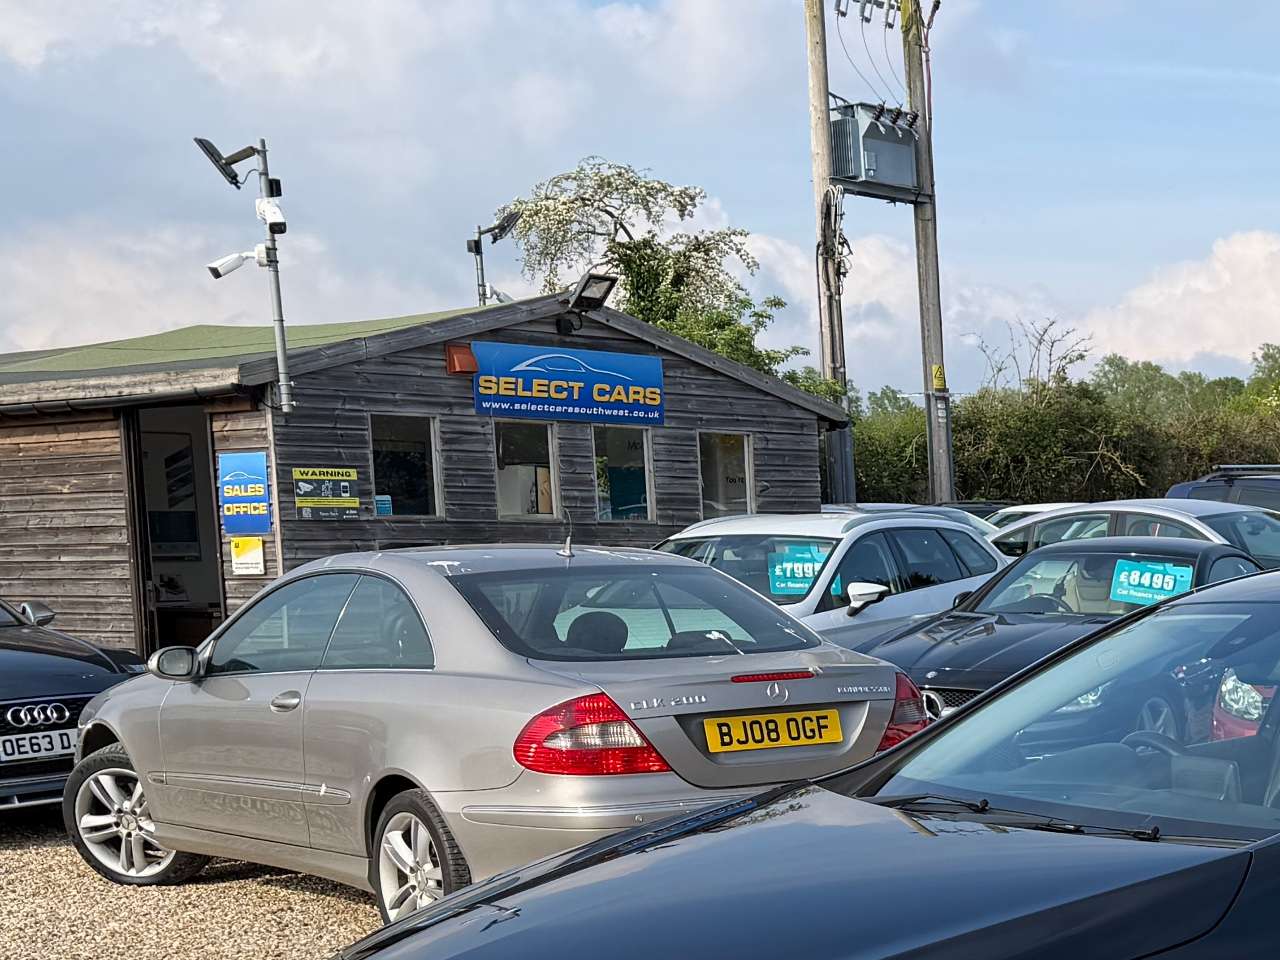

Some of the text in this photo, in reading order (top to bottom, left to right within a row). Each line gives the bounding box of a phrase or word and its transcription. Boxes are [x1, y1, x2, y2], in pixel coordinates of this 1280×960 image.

[478, 375, 661, 406] SELECT CARS
[482, 400, 660, 419] www.selectcarssouthwest.co.uk
[299, 470, 352, 478] WARNING
[223, 484, 265, 496] SALES
[223, 503, 268, 515] OFFICE
[1119, 570, 1175, 591] £8495
[631, 695, 707, 710] CLK 200
[716, 714, 829, 747] BJ08 OGF
[2, 733, 55, 757] OE63
